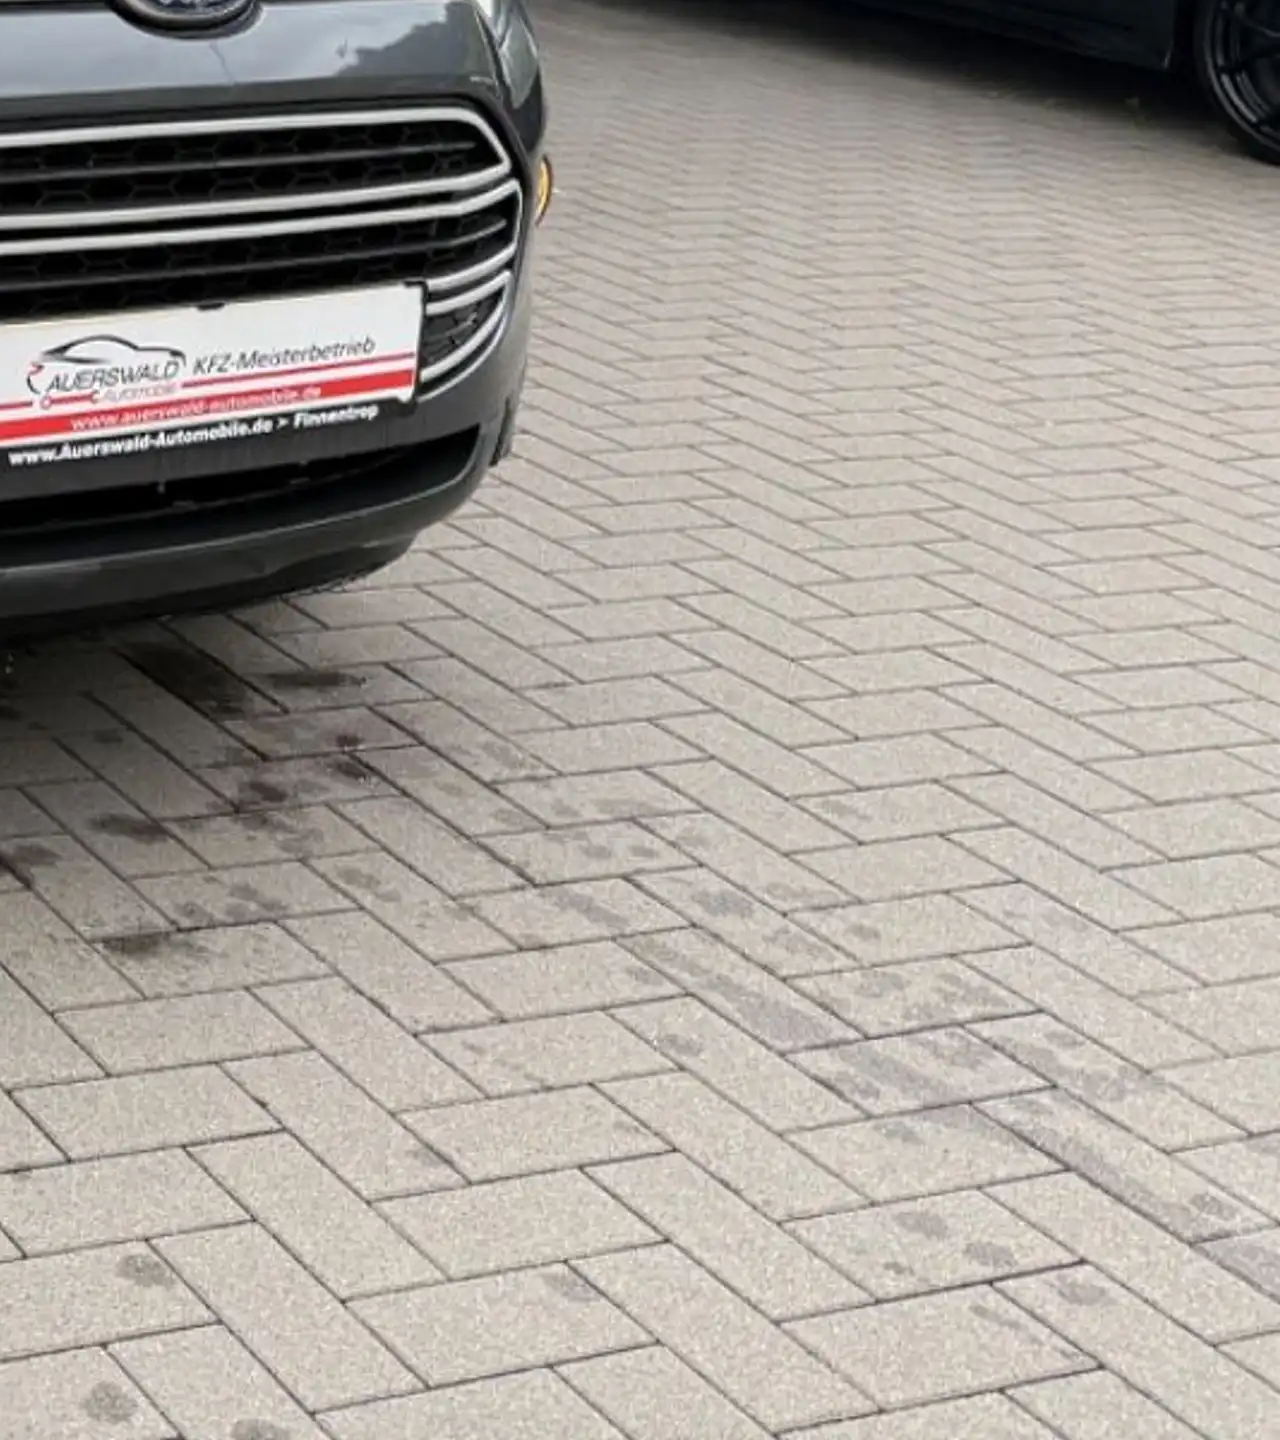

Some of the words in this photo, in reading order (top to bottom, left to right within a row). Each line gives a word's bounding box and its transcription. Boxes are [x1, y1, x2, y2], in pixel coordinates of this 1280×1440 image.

[45, 360, 180, 392] AUERSWALD
[193, 335, 377, 374] KFZ-Meisterbetrieb
[8, 416, 274, 466] www.Auerswald-Automobile.de
[293, 404, 380, 430] Finnentrop
